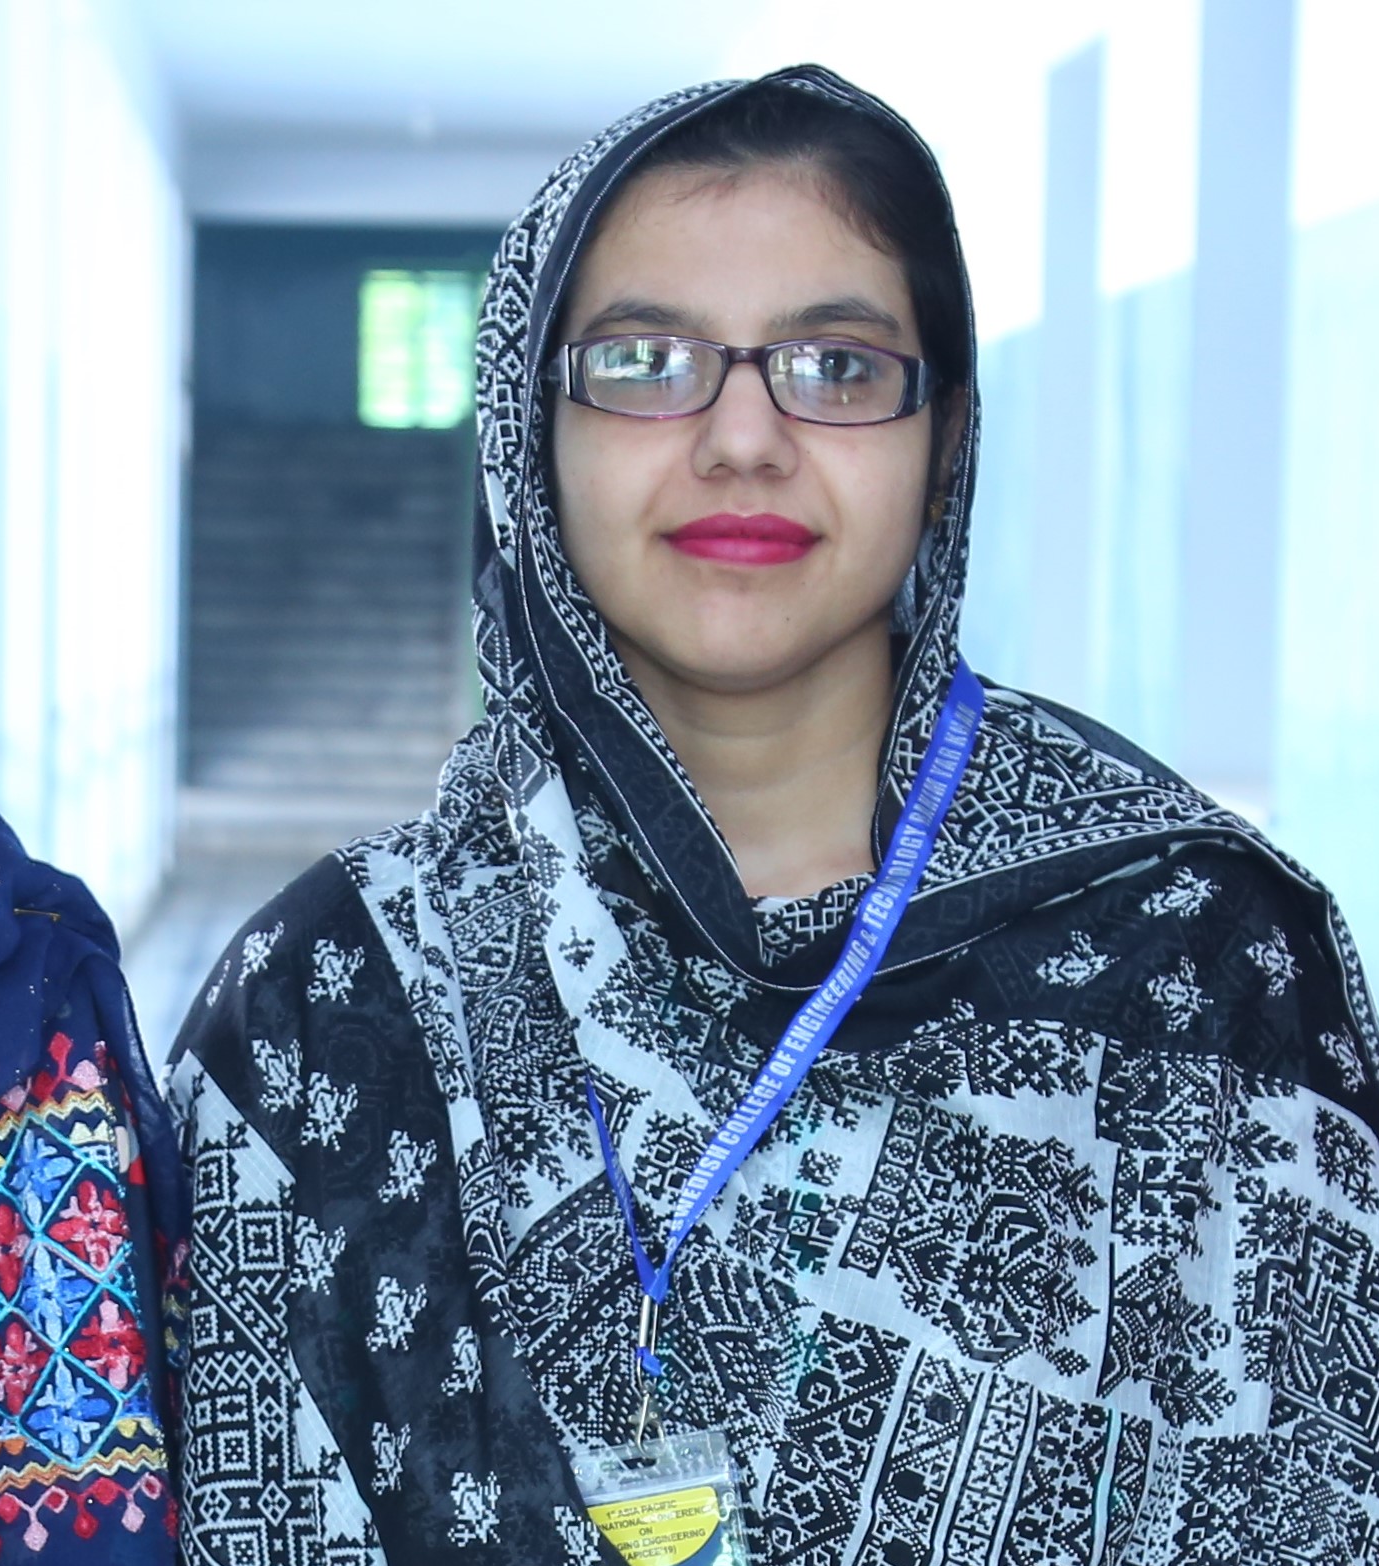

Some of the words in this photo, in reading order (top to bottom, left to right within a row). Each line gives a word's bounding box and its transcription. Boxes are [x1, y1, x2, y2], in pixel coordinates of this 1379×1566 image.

[861, 825, 927, 930] TECHNOLOGY
[860, 928, 879, 947] &
[784, 939, 872, 1053] ENGINEERING
[772, 1050, 797, 1078] OF
[723, 1074, 783, 1146] COLLEGE
[672, 1143, 731, 1232] SWEDISH
[639, 1526, 653, 1537] ON
